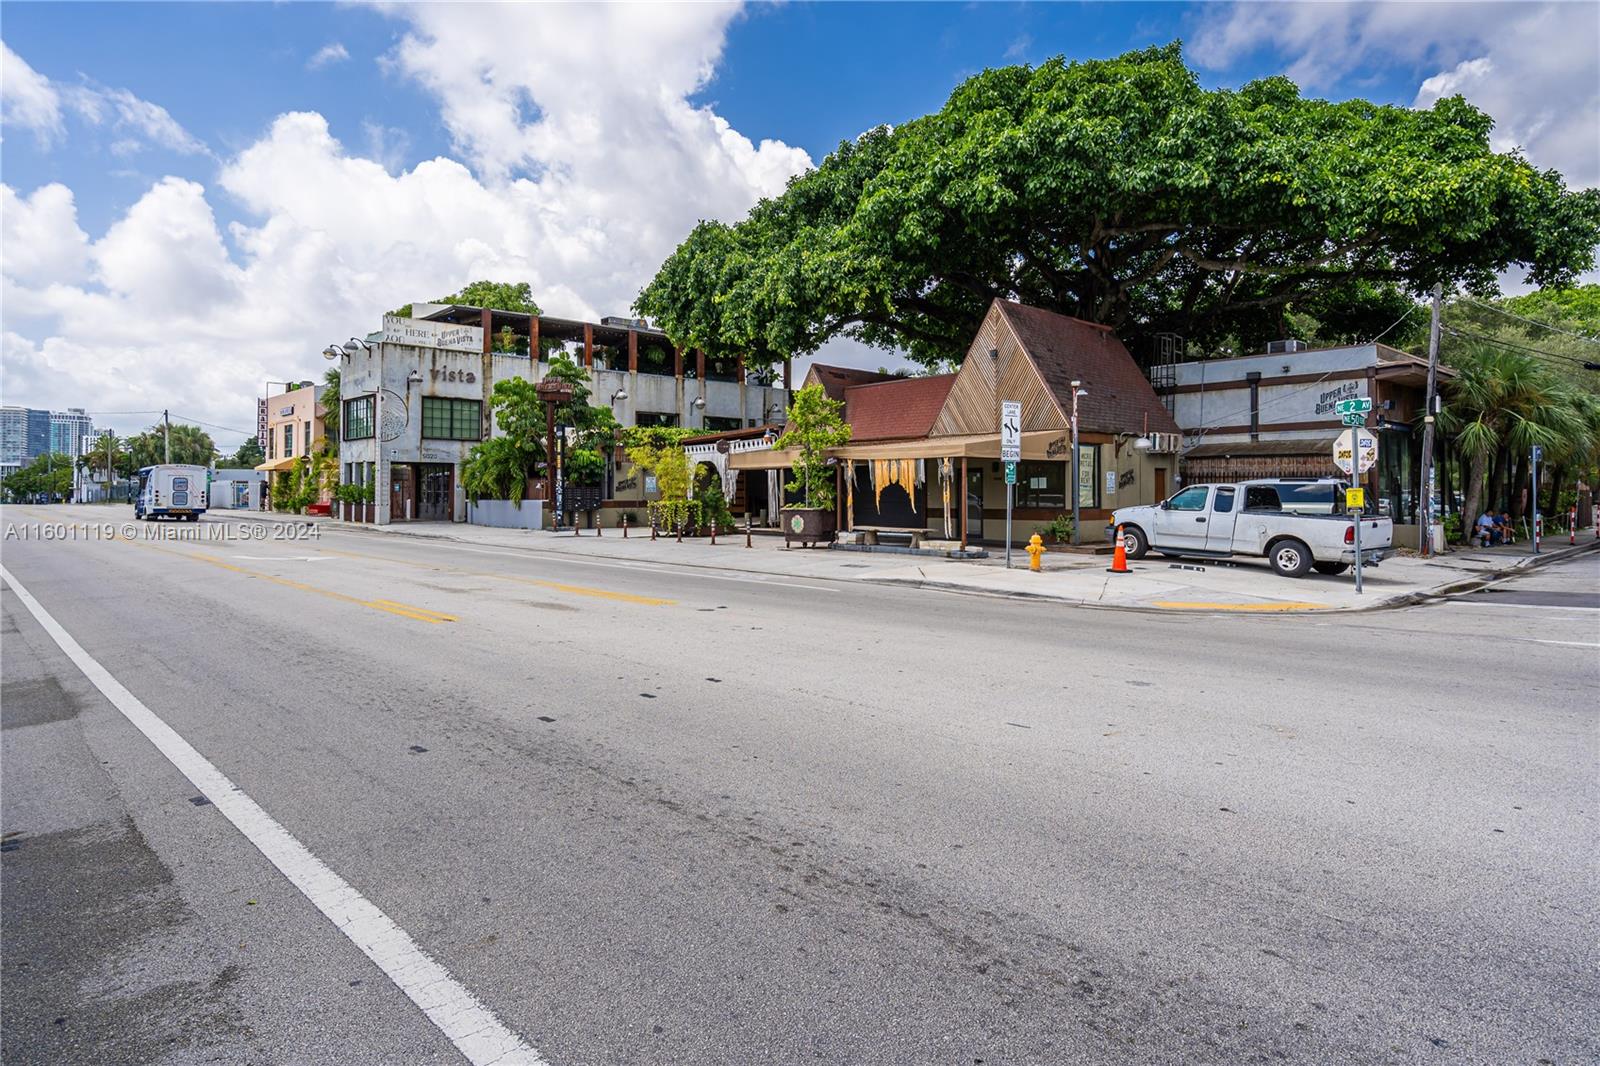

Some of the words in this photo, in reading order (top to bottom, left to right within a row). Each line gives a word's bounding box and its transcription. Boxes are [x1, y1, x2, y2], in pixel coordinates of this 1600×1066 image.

[405, 328, 429, 339] HERE
[441, 328, 460, 339] UPPER
[437, 337, 456, 347] BUENA
[456, 335, 473, 345] VISTA
[429, 365, 476, 384] vista
[1320, 387, 1342, 404] UPPER
[1337, 403, 1345, 413] NE
[1349, 401, 1356, 412] 2
[1361, 400, 1370, 409] AV
[1343, 415, 1351, 423] NE
[1350, 414, 1360, 425] 50
[1002, 450, 1020, 458] BEGIN
